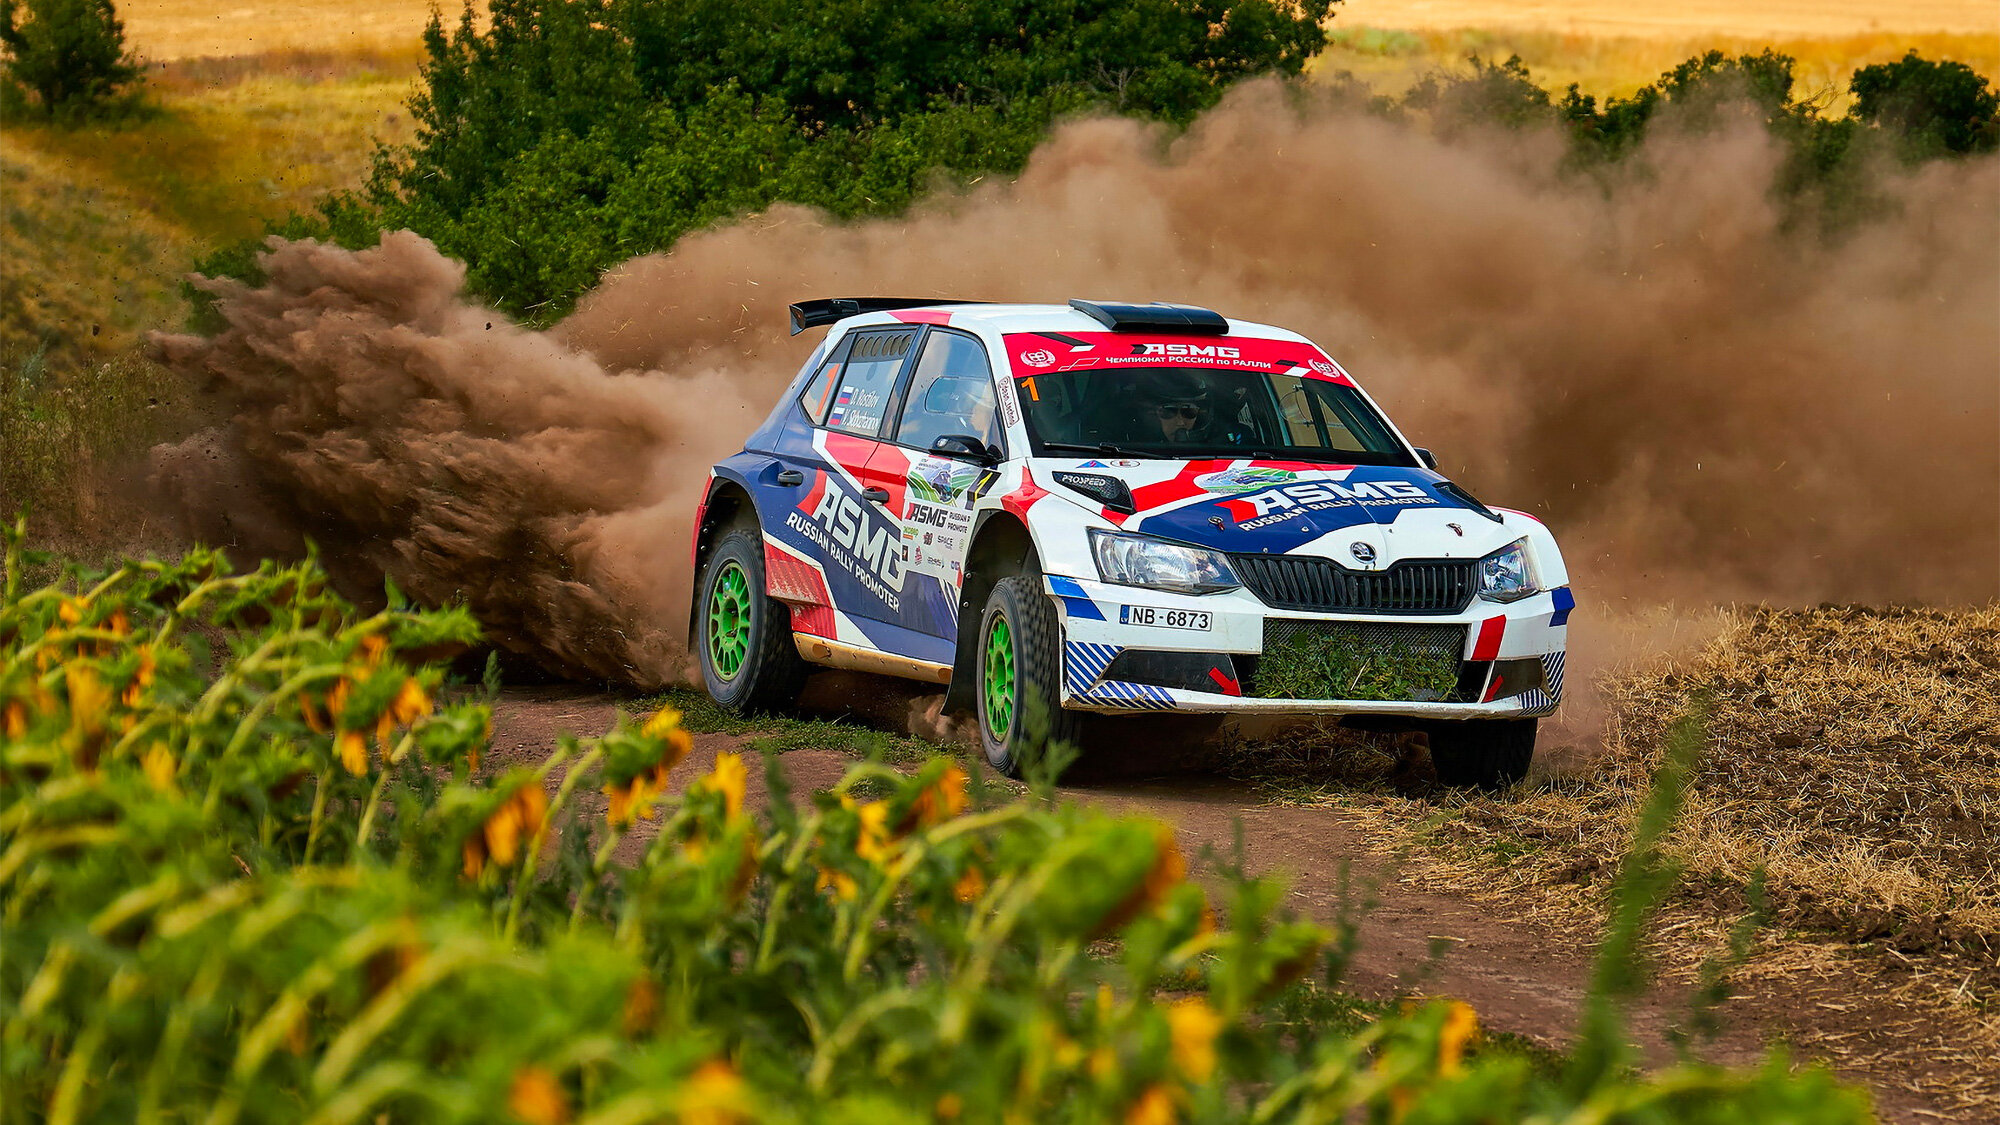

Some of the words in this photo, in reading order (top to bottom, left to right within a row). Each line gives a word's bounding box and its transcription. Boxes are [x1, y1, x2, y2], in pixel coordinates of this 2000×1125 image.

[1142, 343, 1240, 359] ASMG
[1168, 355, 1214, 364] РОССИИ
[1232, 359, 1272, 369] РАЛЛИ
[816, 363, 840, 416] 1
[1020, 376, 1040, 402] 1
[1061, 474, 1106, 487] PROSPEED
[1237, 481, 1428, 517] ASMG
[908, 504, 949, 528] ASMG
[949, 512, 967, 522] RUSSIAN
[1238, 506, 1309, 532] RUSSIAN
[1306, 499, 1356, 511] RALLY
[1359, 497, 1440, 507] PROMOTER
[811, 474, 908, 593] ASMG
[785, 511, 829, 552] RUSSIAN
[830, 542, 854, 573] RALLY
[855, 564, 900, 614] PROMOTER
